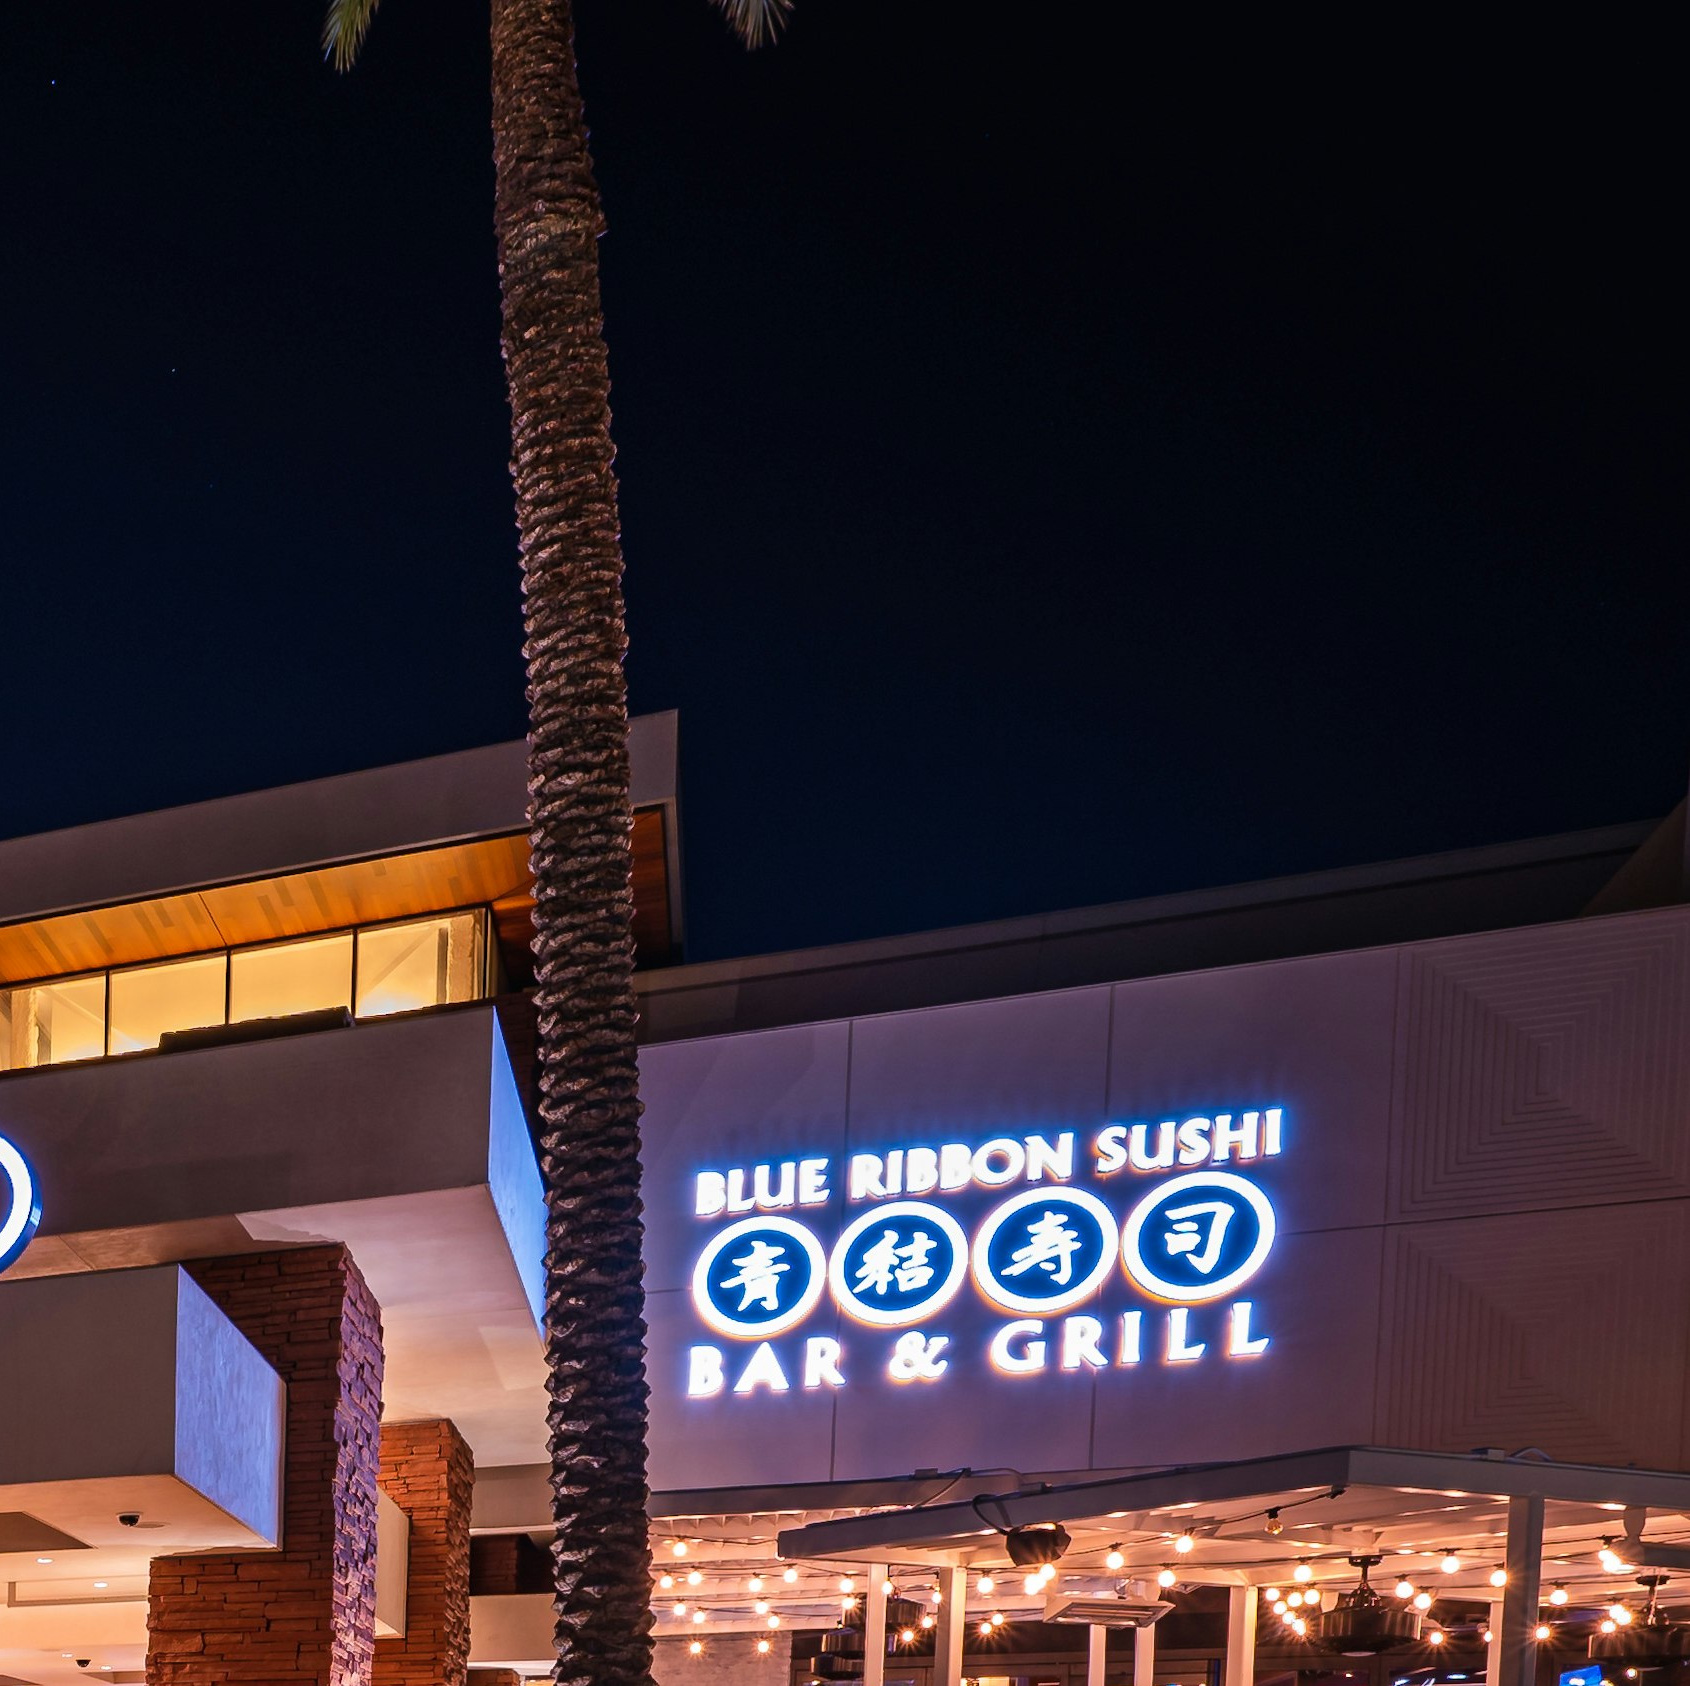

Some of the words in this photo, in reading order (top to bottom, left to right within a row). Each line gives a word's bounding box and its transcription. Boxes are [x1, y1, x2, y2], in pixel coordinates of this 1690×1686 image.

[694, 1157, 831, 1216] BLUE
[849, 1131, 1075, 1200] RIBBON
[1095, 1108, 1283, 1173] SUSHI
[686, 1336, 847, 1400] BAR
[887, 1330, 950, 1382] &
[989, 1300, 1271, 1376] GRILL
